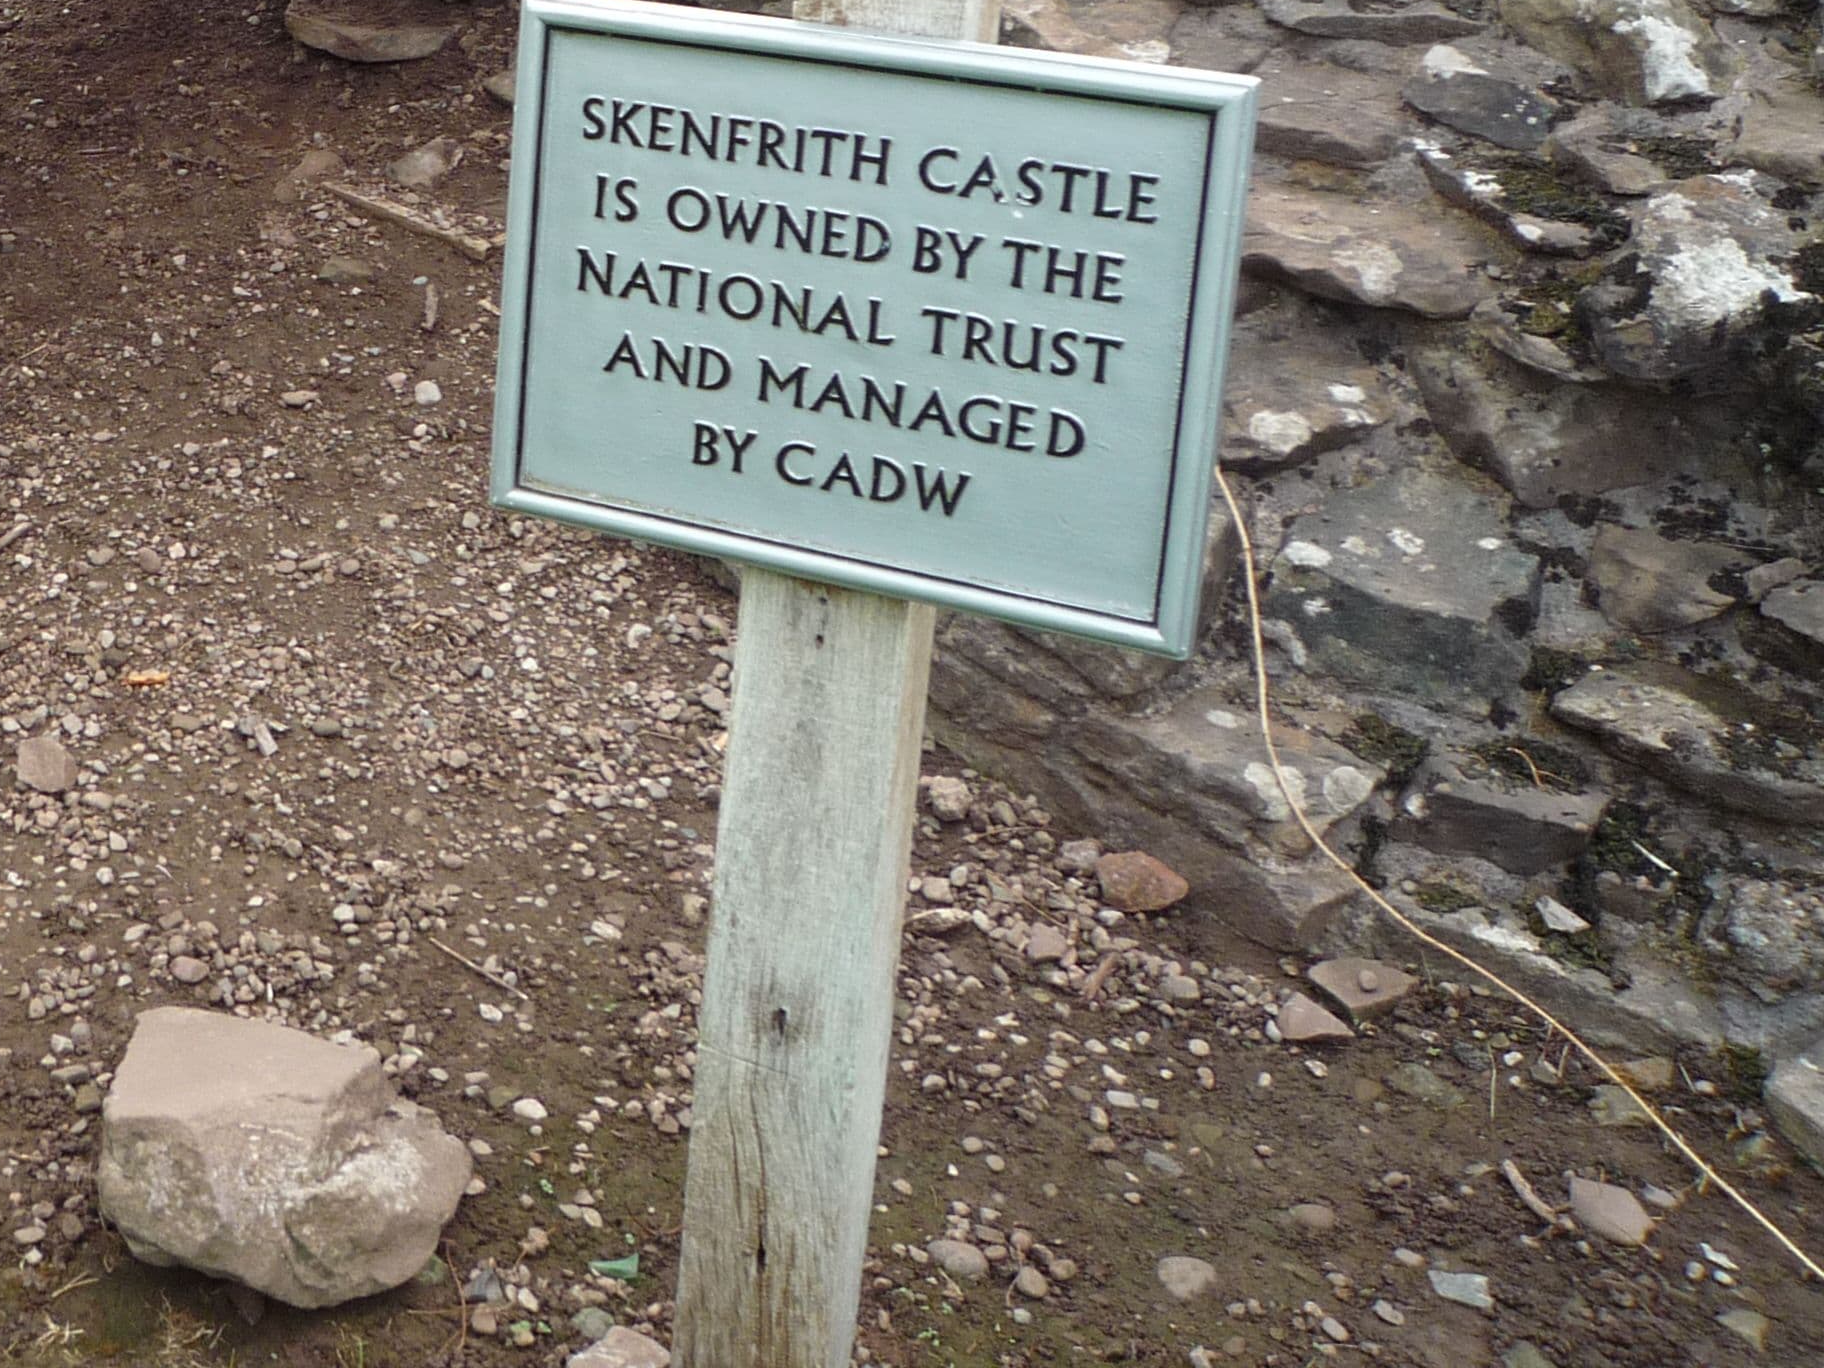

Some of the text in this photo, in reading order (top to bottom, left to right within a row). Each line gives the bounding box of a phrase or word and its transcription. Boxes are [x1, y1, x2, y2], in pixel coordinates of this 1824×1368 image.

[581, 96, 1162, 226] SKENFRITH CASTLE
[594, 173, 1127, 305] IS OWNED BY THE
[576, 246, 1127, 386] NATIONAL TRUST
[603, 330, 1086, 459] AND MANAGED
[692, 420, 972, 518] BY CADW
